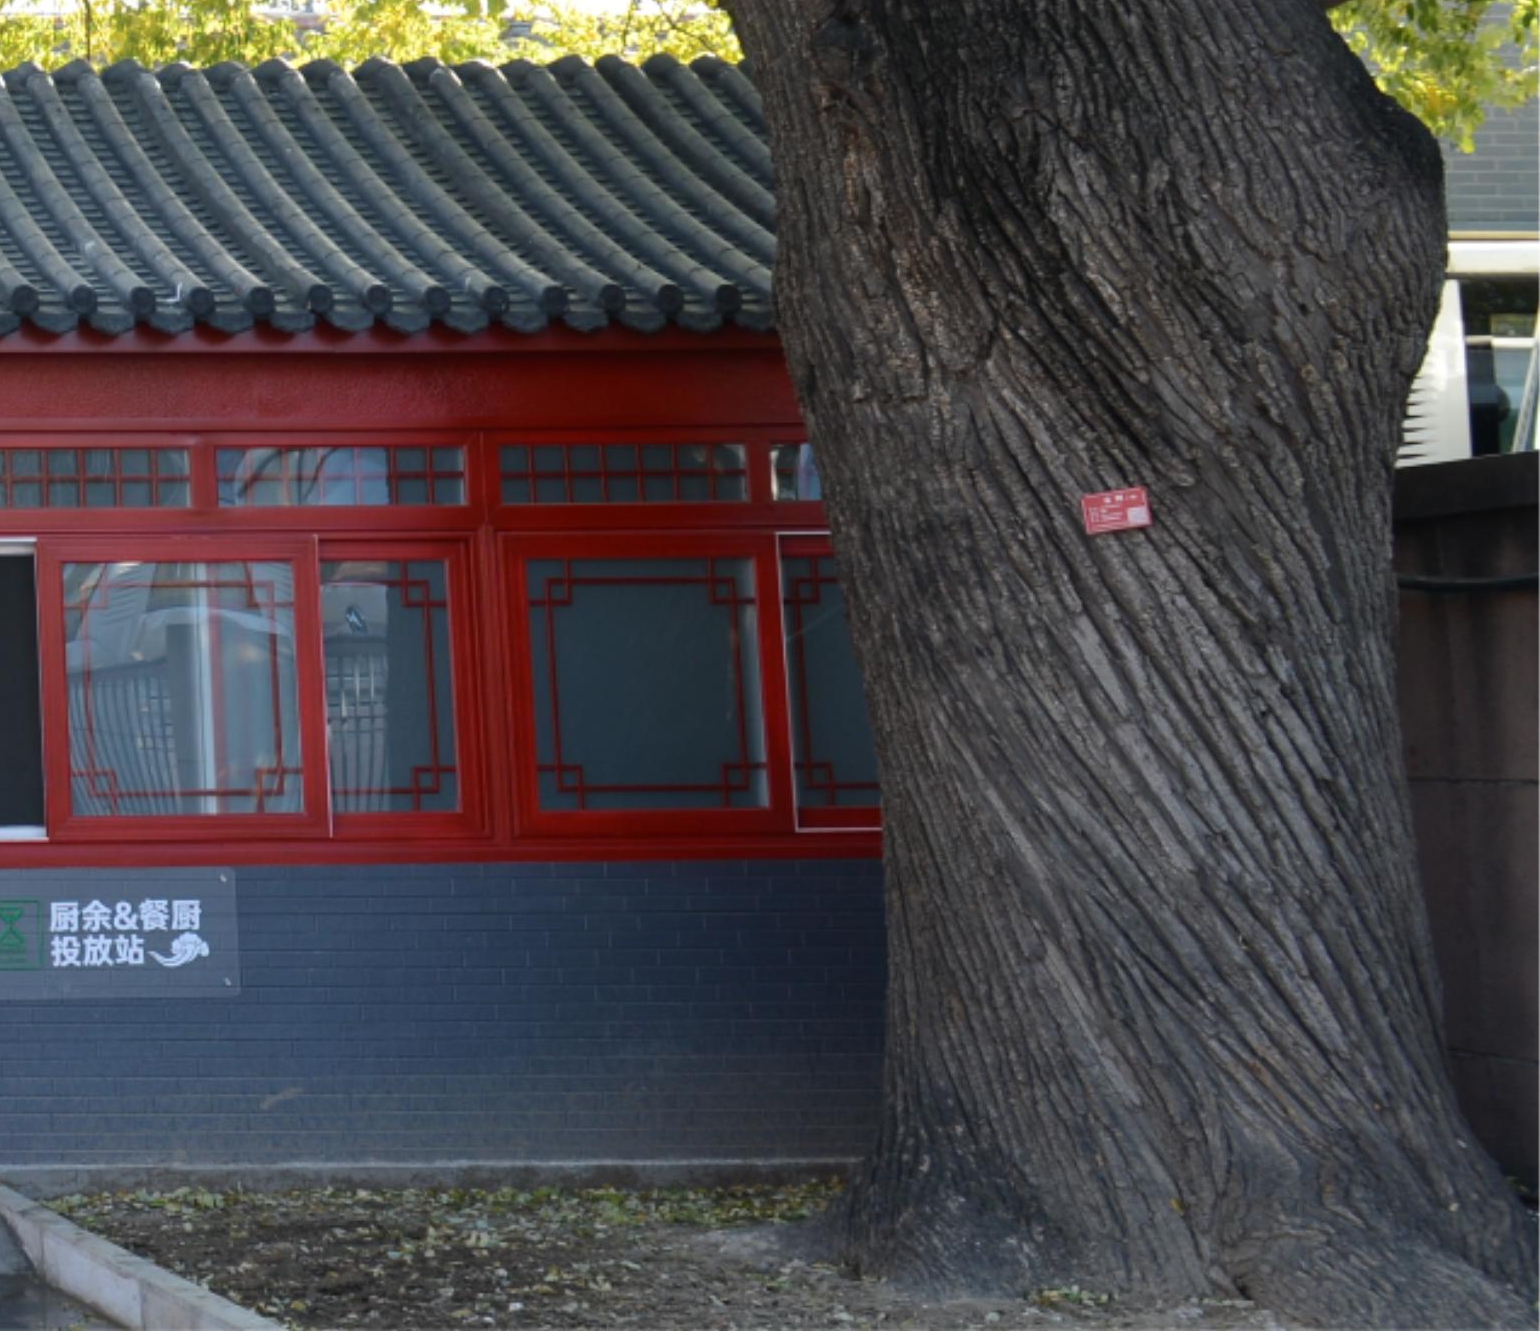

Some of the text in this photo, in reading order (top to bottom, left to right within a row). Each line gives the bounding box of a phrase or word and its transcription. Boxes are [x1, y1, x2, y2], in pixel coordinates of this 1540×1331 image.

[49, 897, 202, 932] 厨余&餐厨
[51, 934, 145, 967] 投放站
